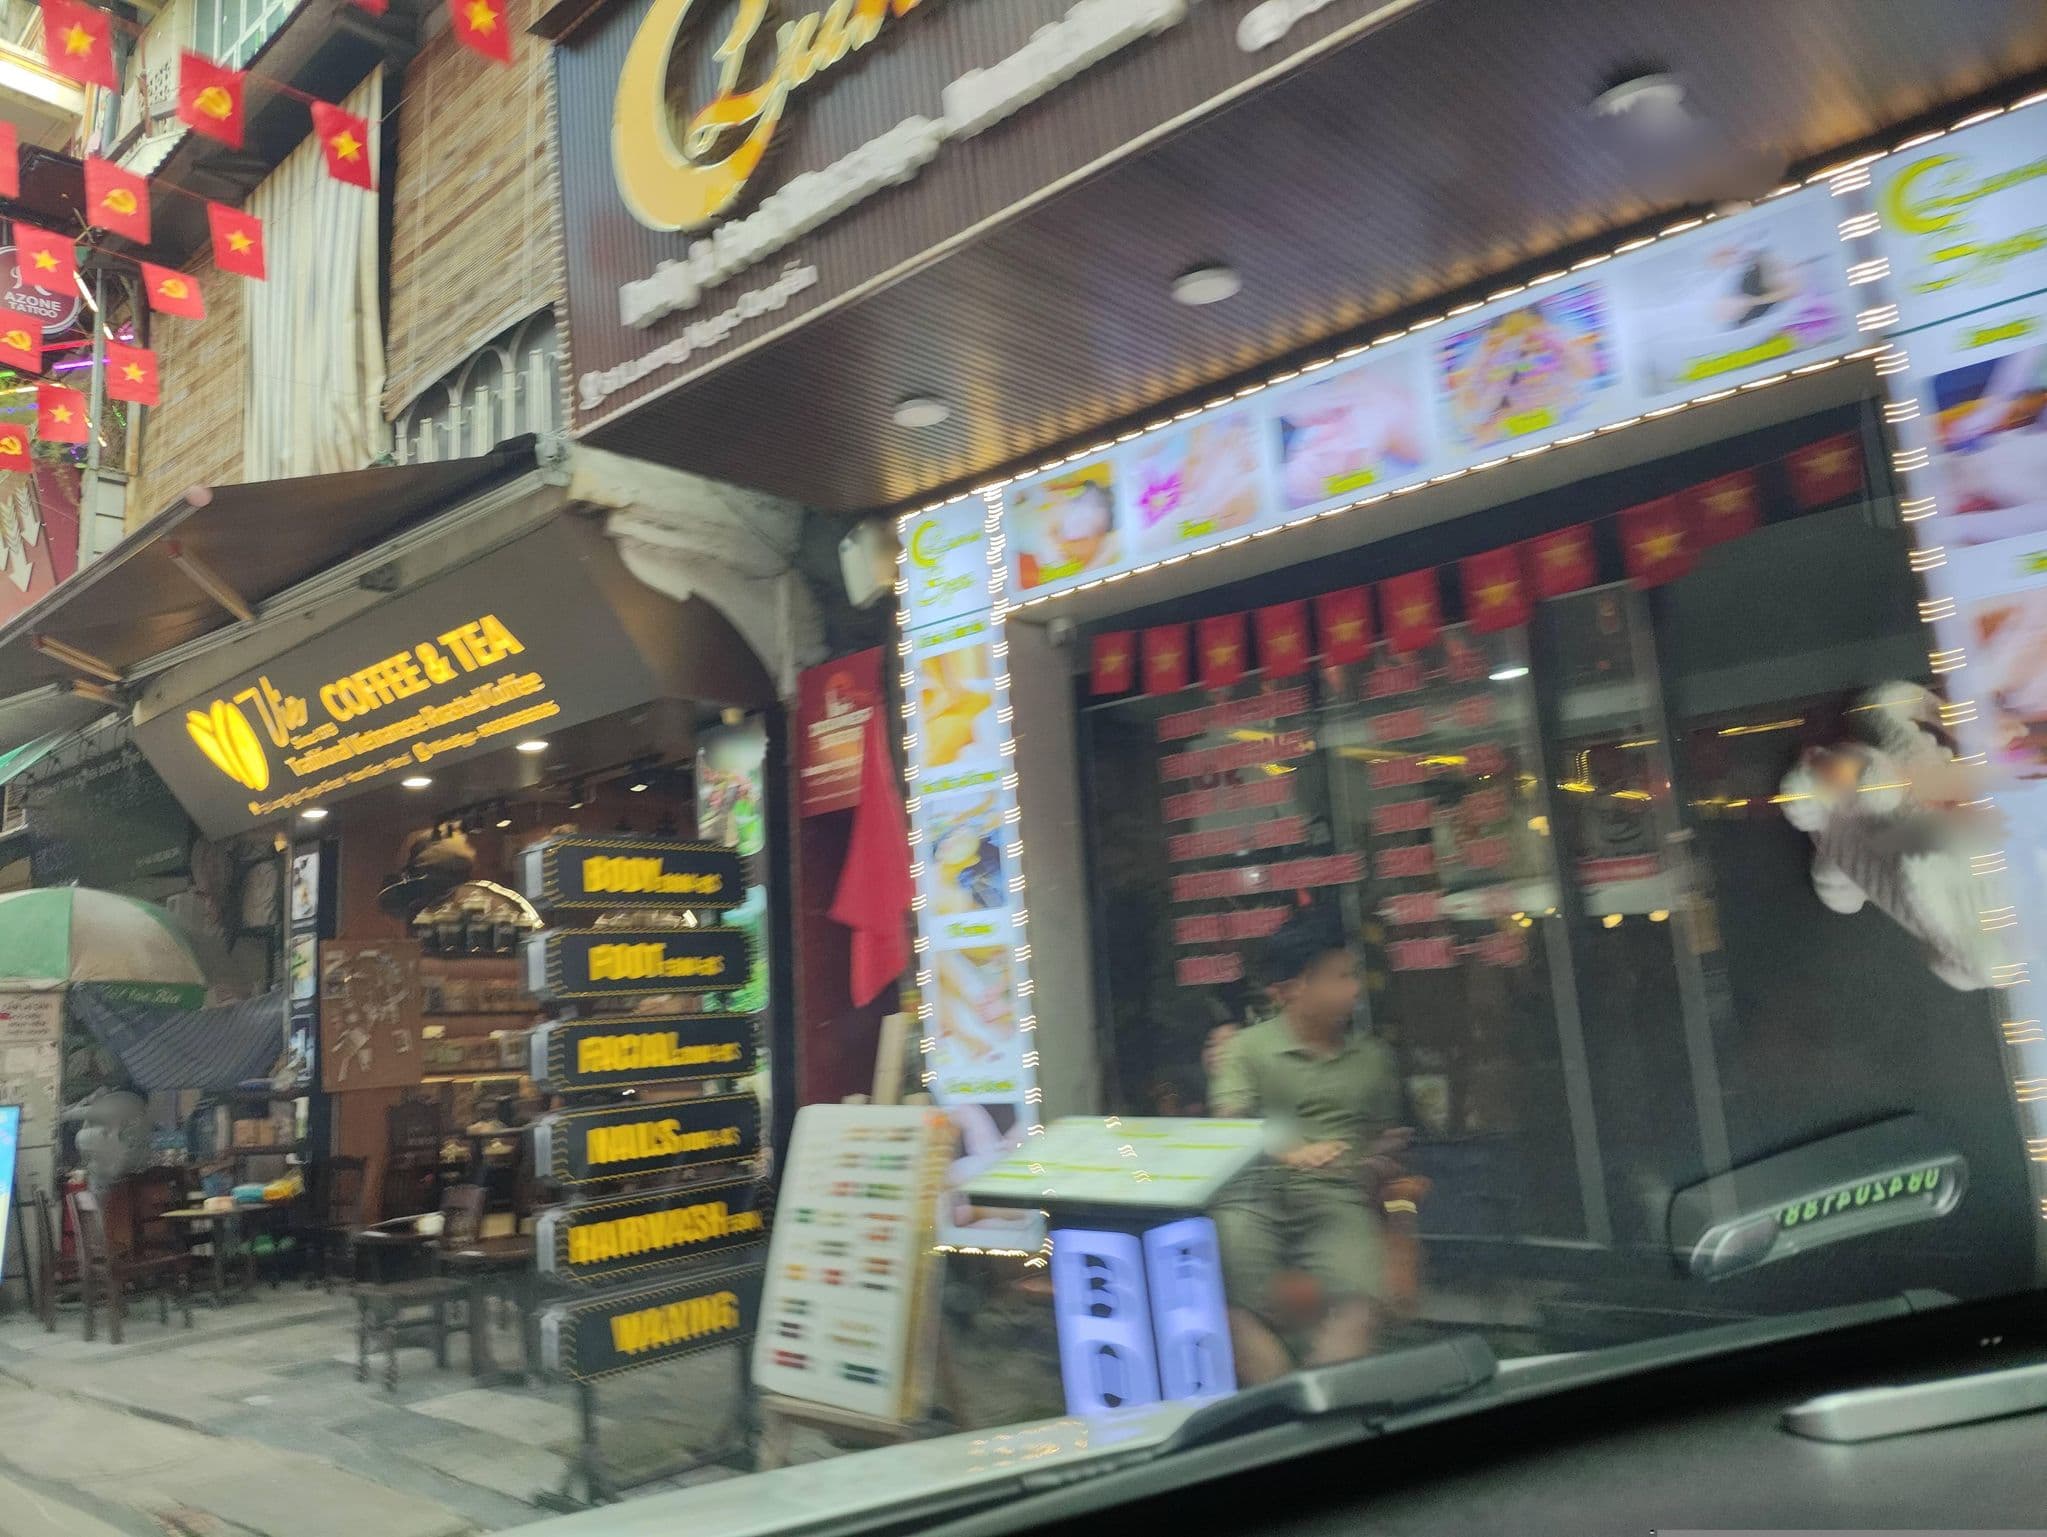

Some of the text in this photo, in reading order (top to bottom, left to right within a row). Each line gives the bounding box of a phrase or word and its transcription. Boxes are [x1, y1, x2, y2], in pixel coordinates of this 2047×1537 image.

[4, 291, 61, 312] AZONE
[8, 301, 58, 318] TATTOO
[320, 651, 432, 722] COFFEE
[415, 642, 459, 684] &
[437, 614, 525, 672] TEA
